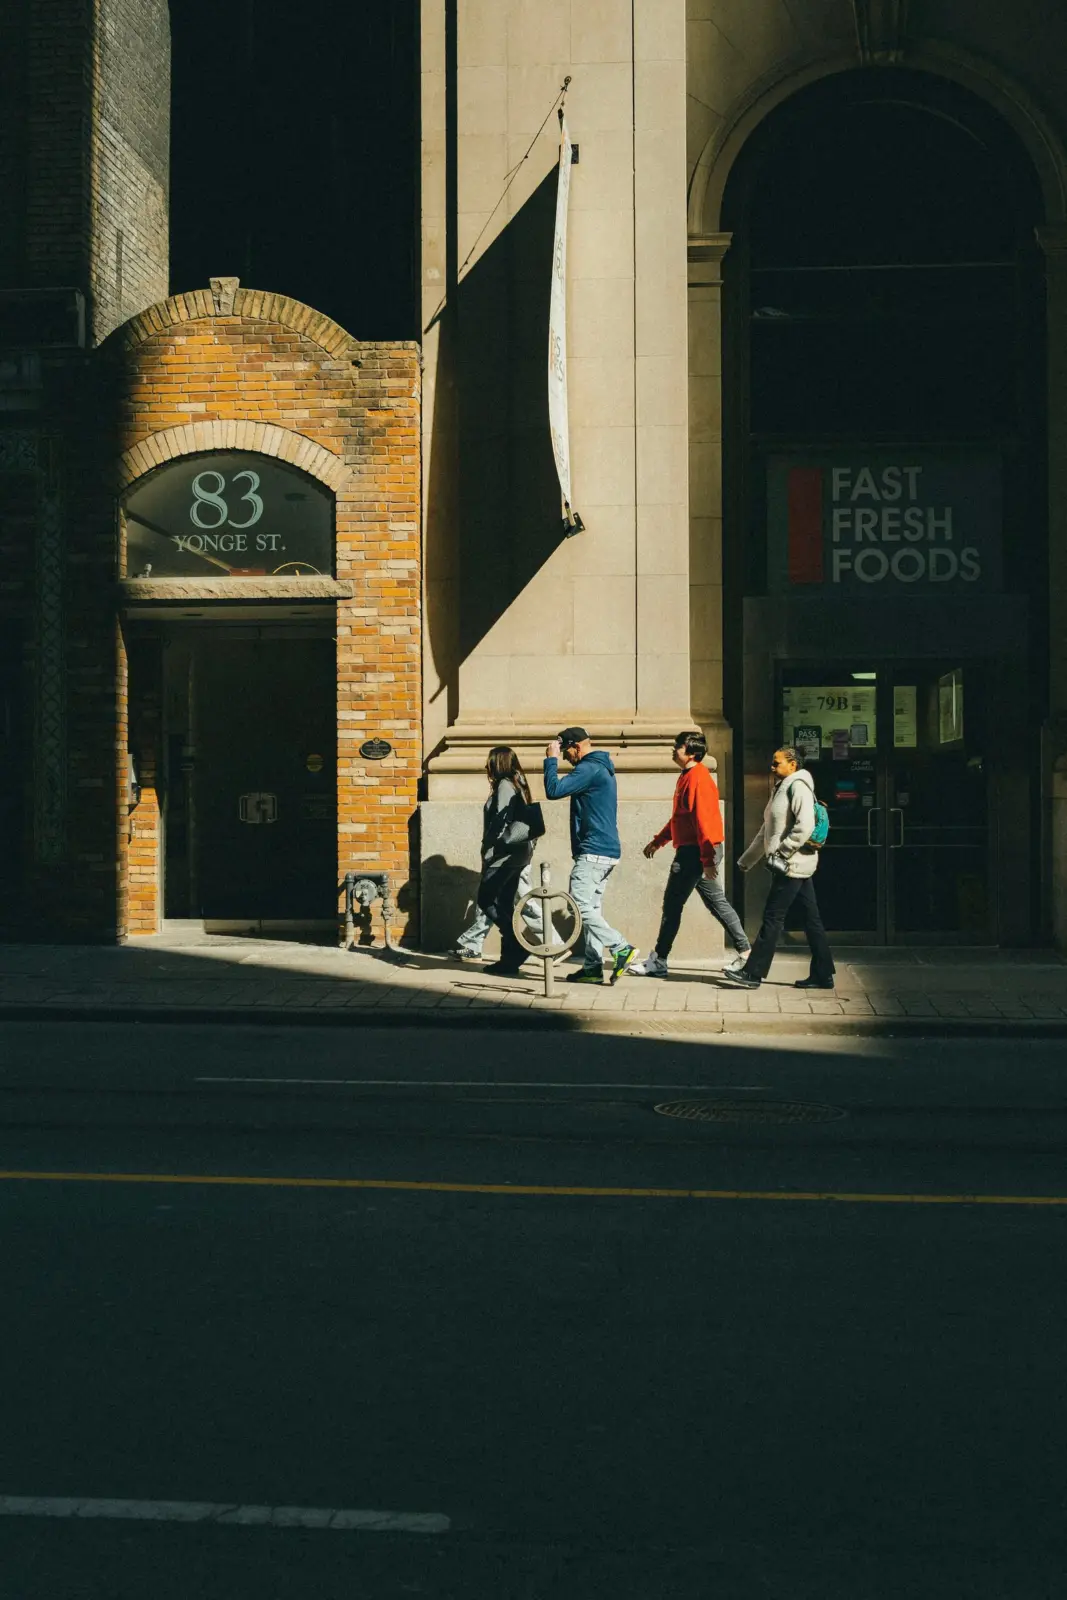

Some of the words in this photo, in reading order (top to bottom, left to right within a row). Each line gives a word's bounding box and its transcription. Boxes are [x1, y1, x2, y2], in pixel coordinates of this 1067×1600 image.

[190, 470, 264, 529] 83
[832, 466, 922, 501] FAST
[832, 507, 953, 542] FRESH
[174, 534, 248, 552] YONGE
[256, 533, 287, 551] ST.
[832, 547, 981, 583] FOODS
[817, 695, 848, 711] 79B
[798, 730, 817, 738] PASS
